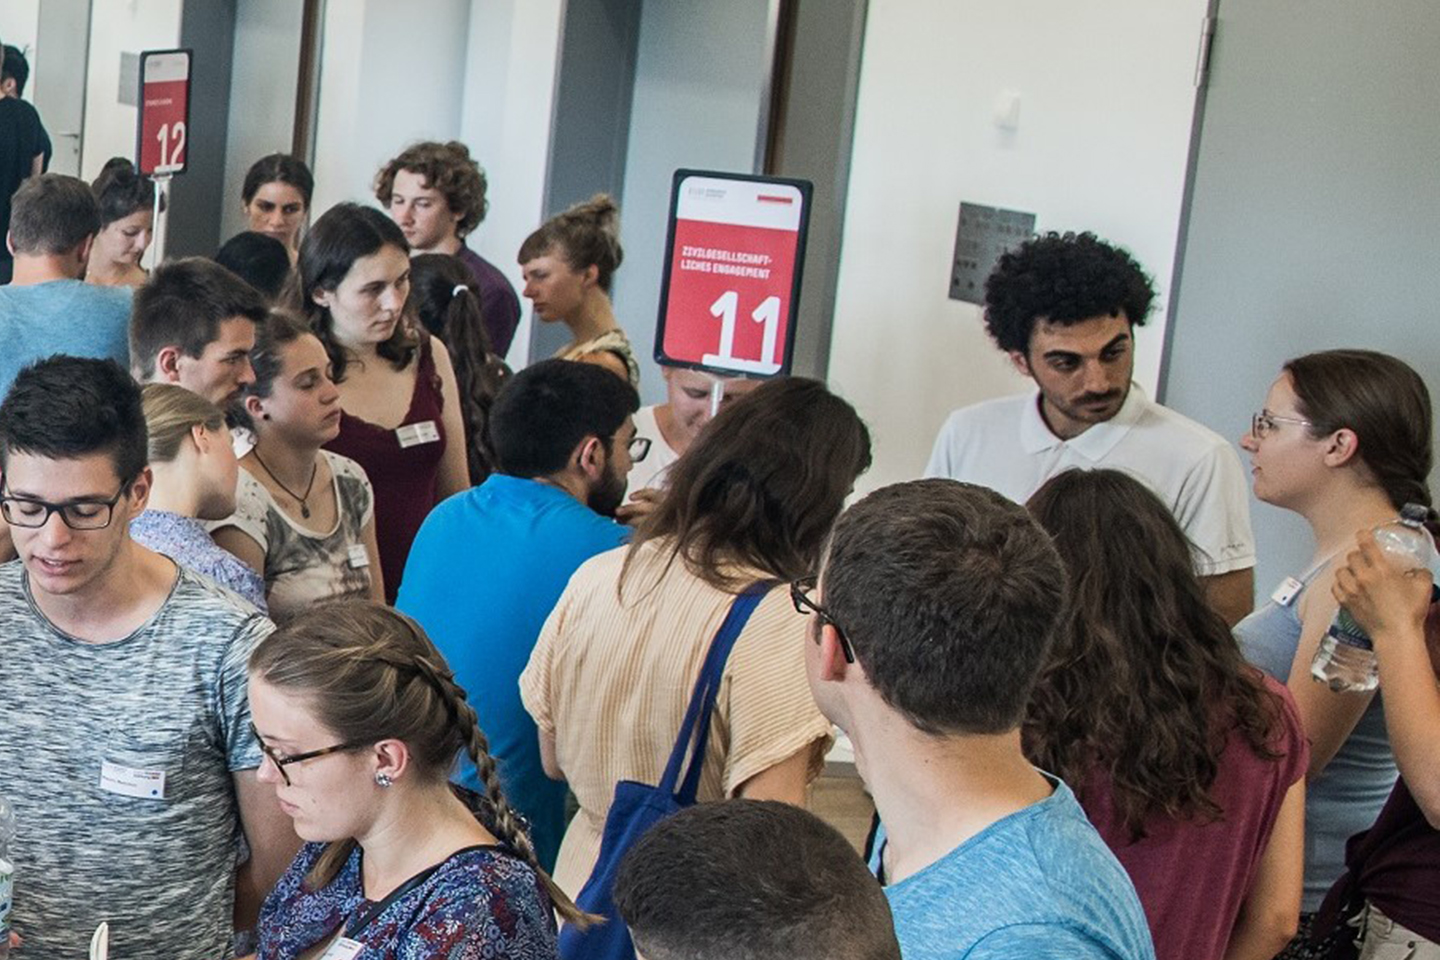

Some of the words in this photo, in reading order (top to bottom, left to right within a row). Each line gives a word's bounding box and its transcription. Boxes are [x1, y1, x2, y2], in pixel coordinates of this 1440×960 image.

[154, 121, 186, 173] 12
[681, 259, 711, 272] LICHES
[712, 263, 771, 279] ENGAGEMENT
[702, 291, 782, 375] 11
